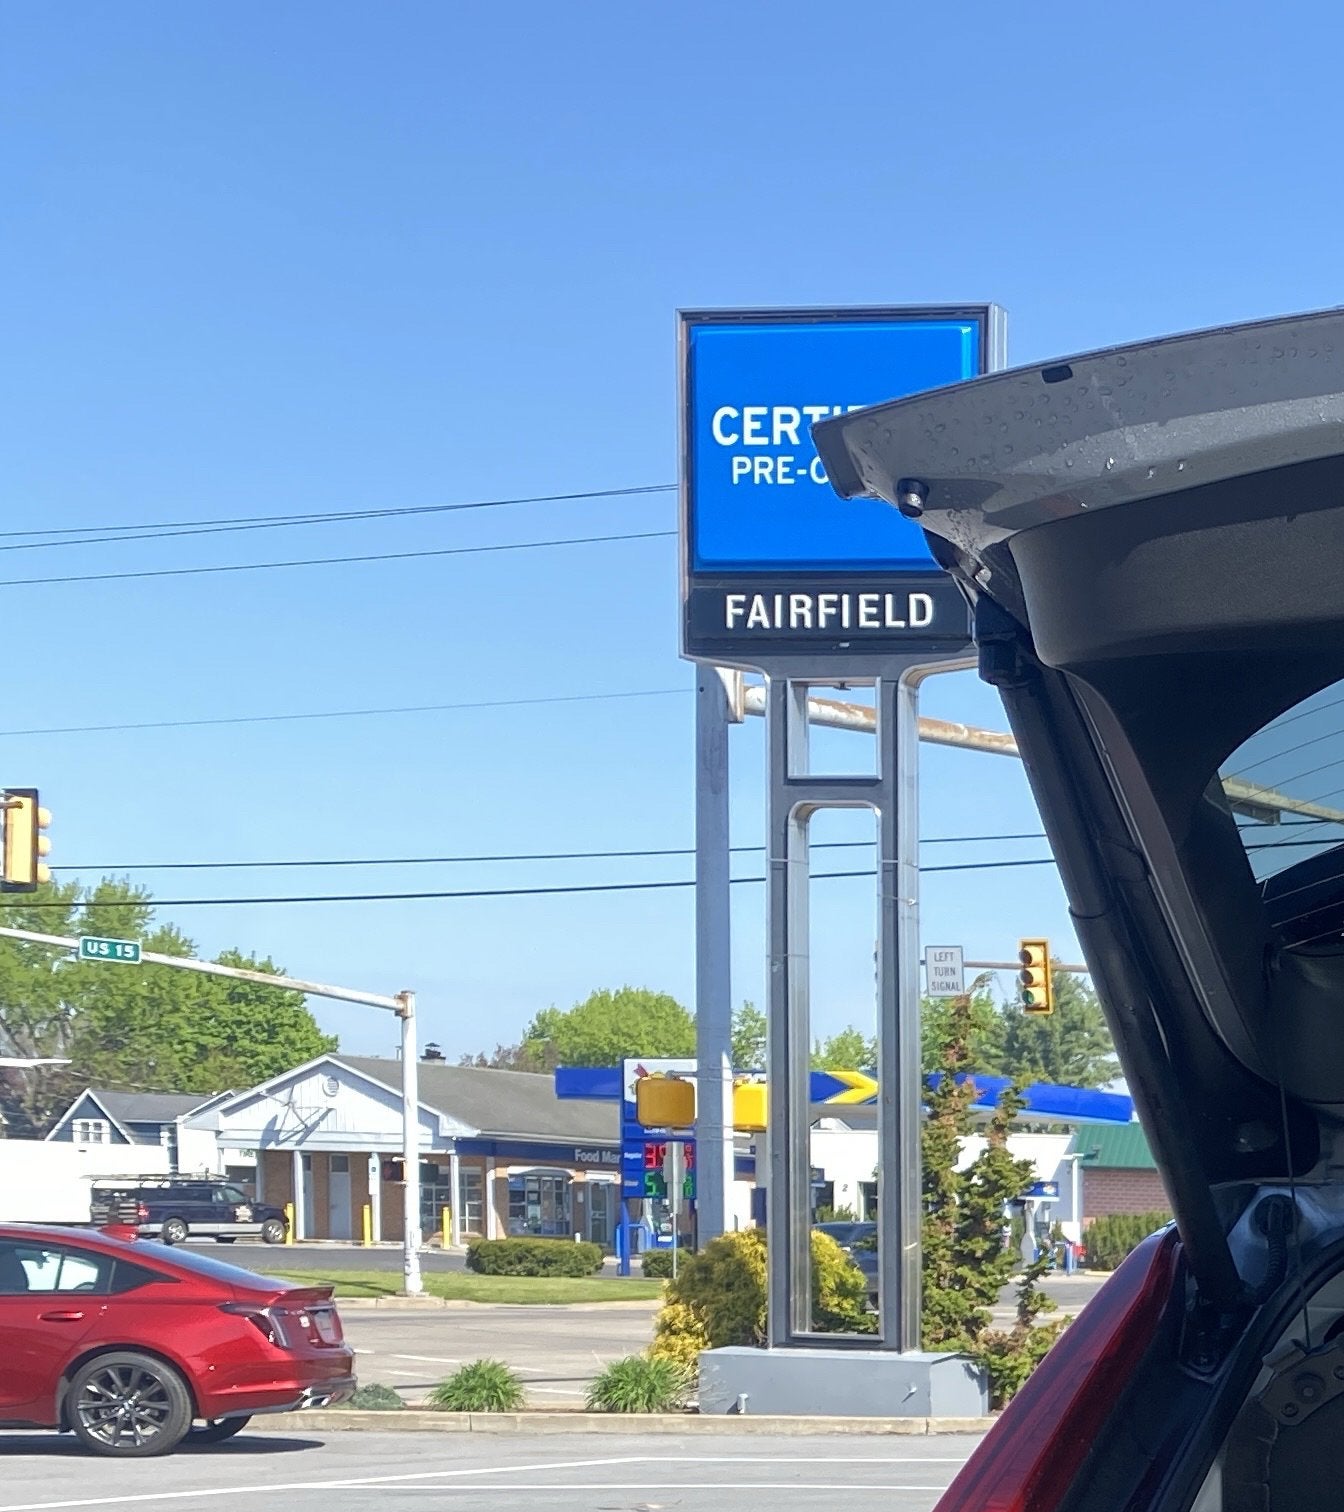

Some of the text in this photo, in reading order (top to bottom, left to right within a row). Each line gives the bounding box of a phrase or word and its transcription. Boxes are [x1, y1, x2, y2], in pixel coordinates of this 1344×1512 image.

[712, 405, 866, 446] CERT
[725, 593, 934, 629] FAIRFIELD
[87, 941, 135, 958] US 15
[934, 951, 954, 962] LEFT
[934, 966, 956, 977] TURN
[931, 981, 961, 991] SIGNAL
[575, 1149, 600, 1162] Food
